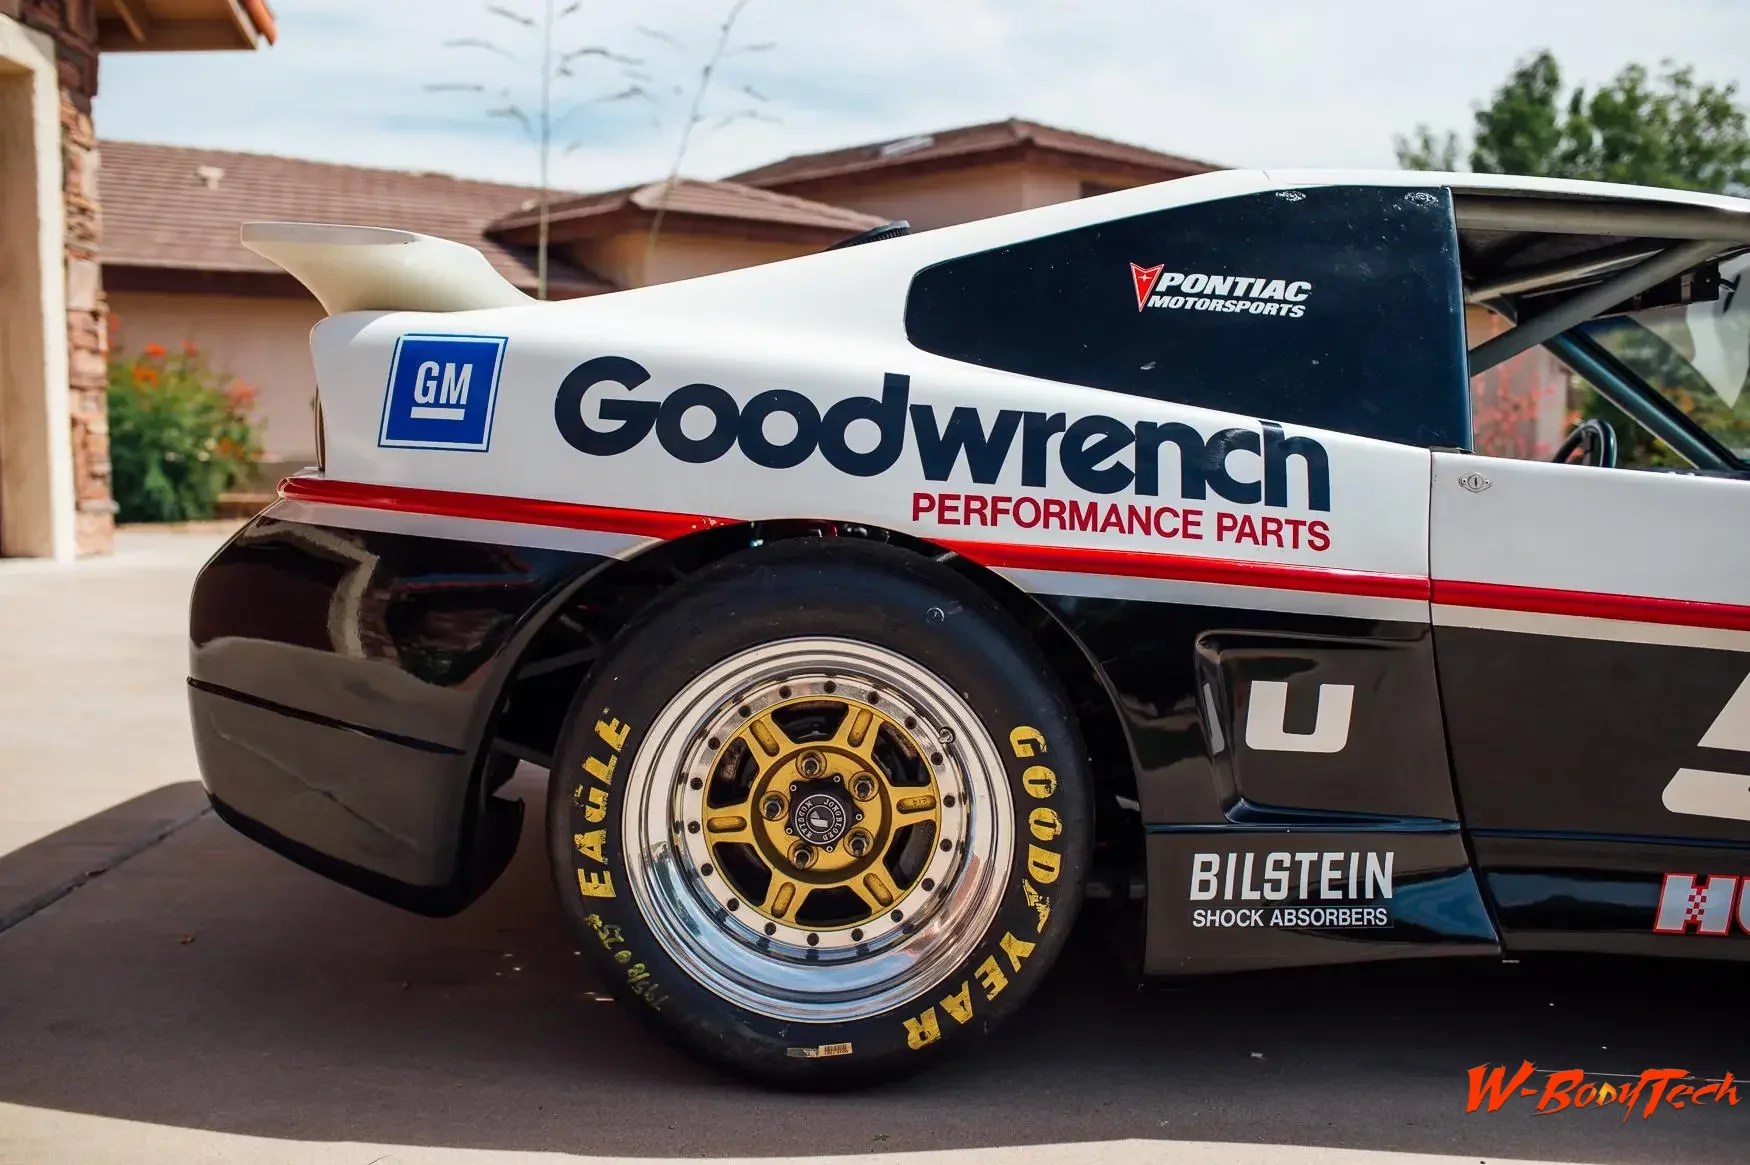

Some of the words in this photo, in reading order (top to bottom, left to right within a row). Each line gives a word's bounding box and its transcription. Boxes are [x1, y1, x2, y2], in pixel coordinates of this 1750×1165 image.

[1147, 295, 1306, 317] MOTORSPORTS
[1155, 273, 1312, 303] PONTIAC
[413, 361, 473, 405] GM
[554, 355, 1332, 512] Goodwrench
[912, 493, 1203, 540] PERFORMANCE
[1215, 511, 1332, 552] PARTS
[1245, 680, 1355, 753] U
[573, 708, 631, 898] EAGLE
[798, 801, 812, 839] MODULAR
[822, 798, 843, 841] JONGBLOED
[1189, 851, 1395, 900] BILSTEIN
[1192, 908, 1265, 928] SHOCK
[1269, 907, 1388, 927] ABSORBERS
